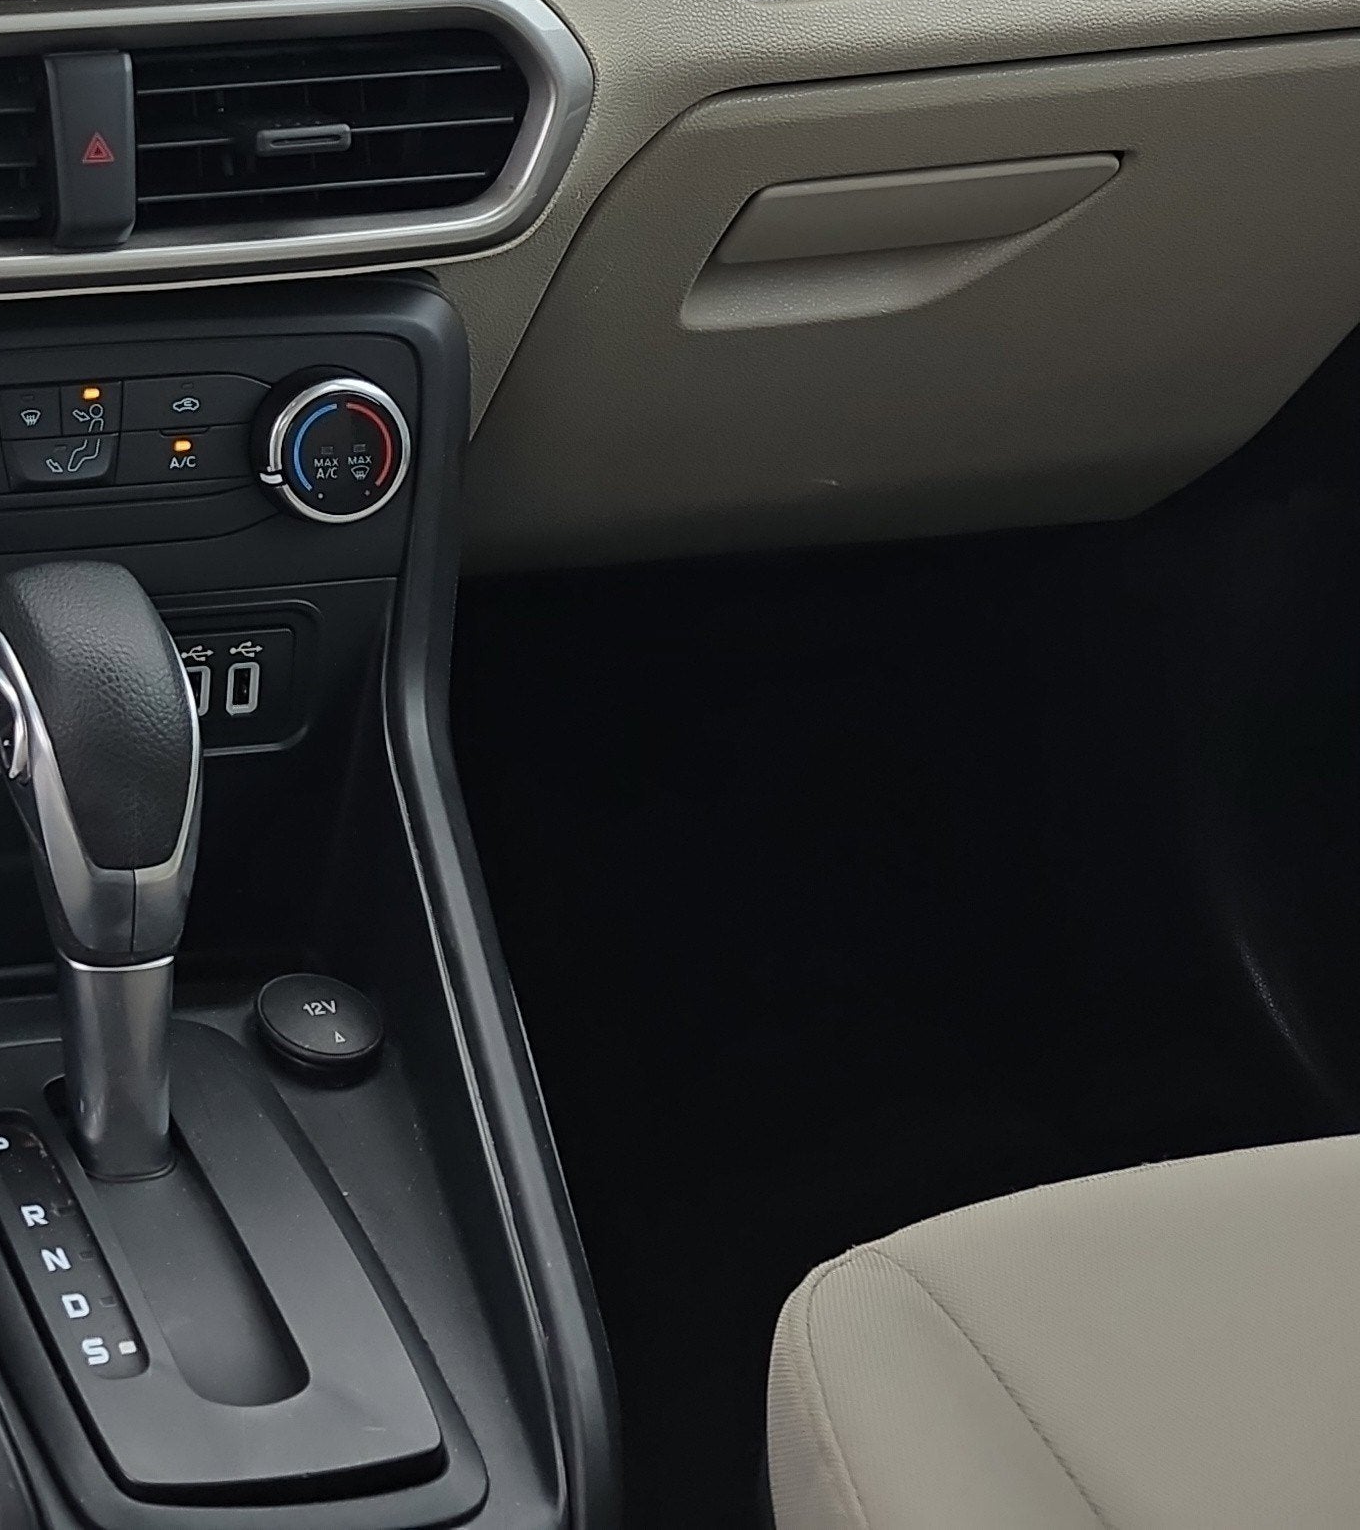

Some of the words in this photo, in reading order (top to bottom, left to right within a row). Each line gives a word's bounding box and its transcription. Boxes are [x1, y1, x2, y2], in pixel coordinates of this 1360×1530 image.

[168, 455, 197, 470] A/C
[313, 457, 339, 468] MAX
[347, 455, 373, 466] MAX
[316, 467, 338, 480] A/C
[301, 998, 338, 1018] 12V
[20, 1204, 48, 1227] R
[40, 1247, 72, 1272] N
[61, 1293, 90, 1319] D
[81, 1336, 111, 1366] S
